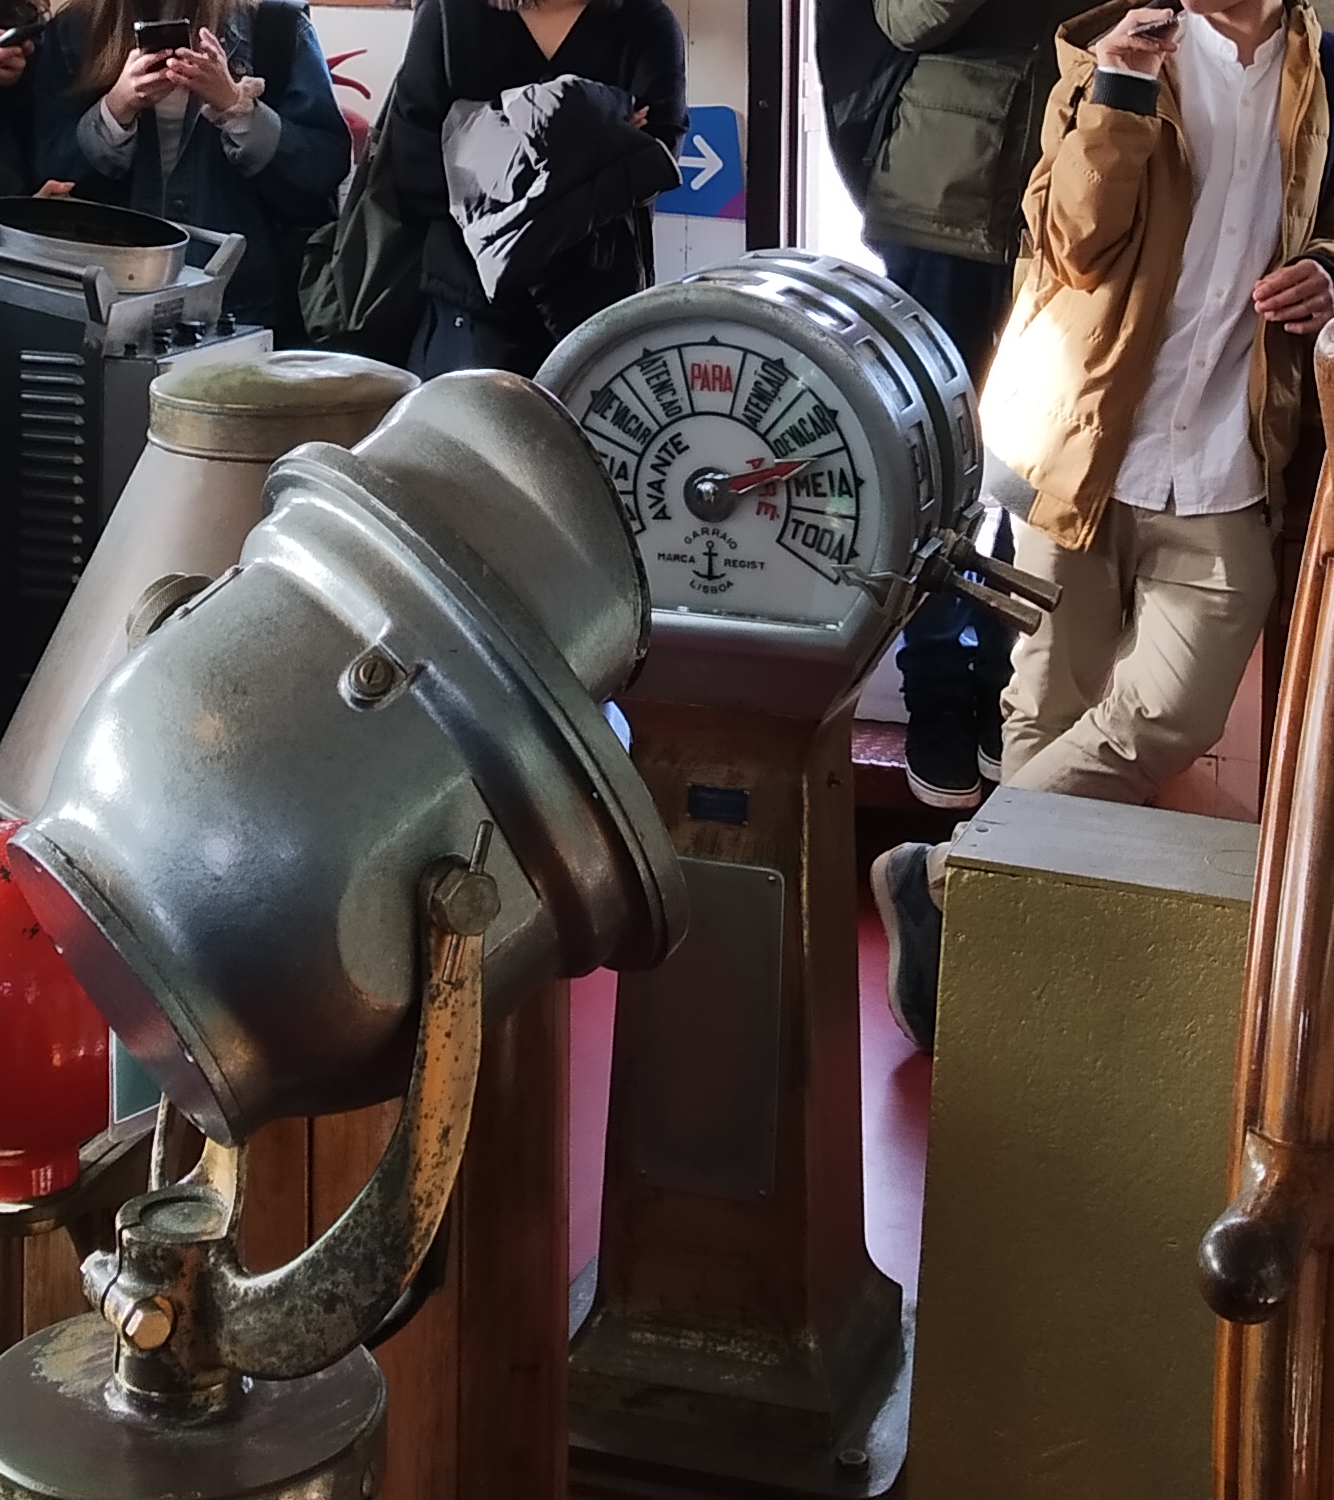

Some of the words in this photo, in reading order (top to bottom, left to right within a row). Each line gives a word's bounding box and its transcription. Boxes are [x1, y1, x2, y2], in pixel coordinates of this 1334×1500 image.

[590, 387, 652, 446] DEVAGAR
[772, 404, 836, 459] DEVAGAR
[646, 431, 691, 521] AVANTE
[793, 467, 854, 498] MEIA
[657, 553, 696, 564] MARCA
[790, 518, 846, 565] TODA
[689, 579, 734, 595] LISBOA
